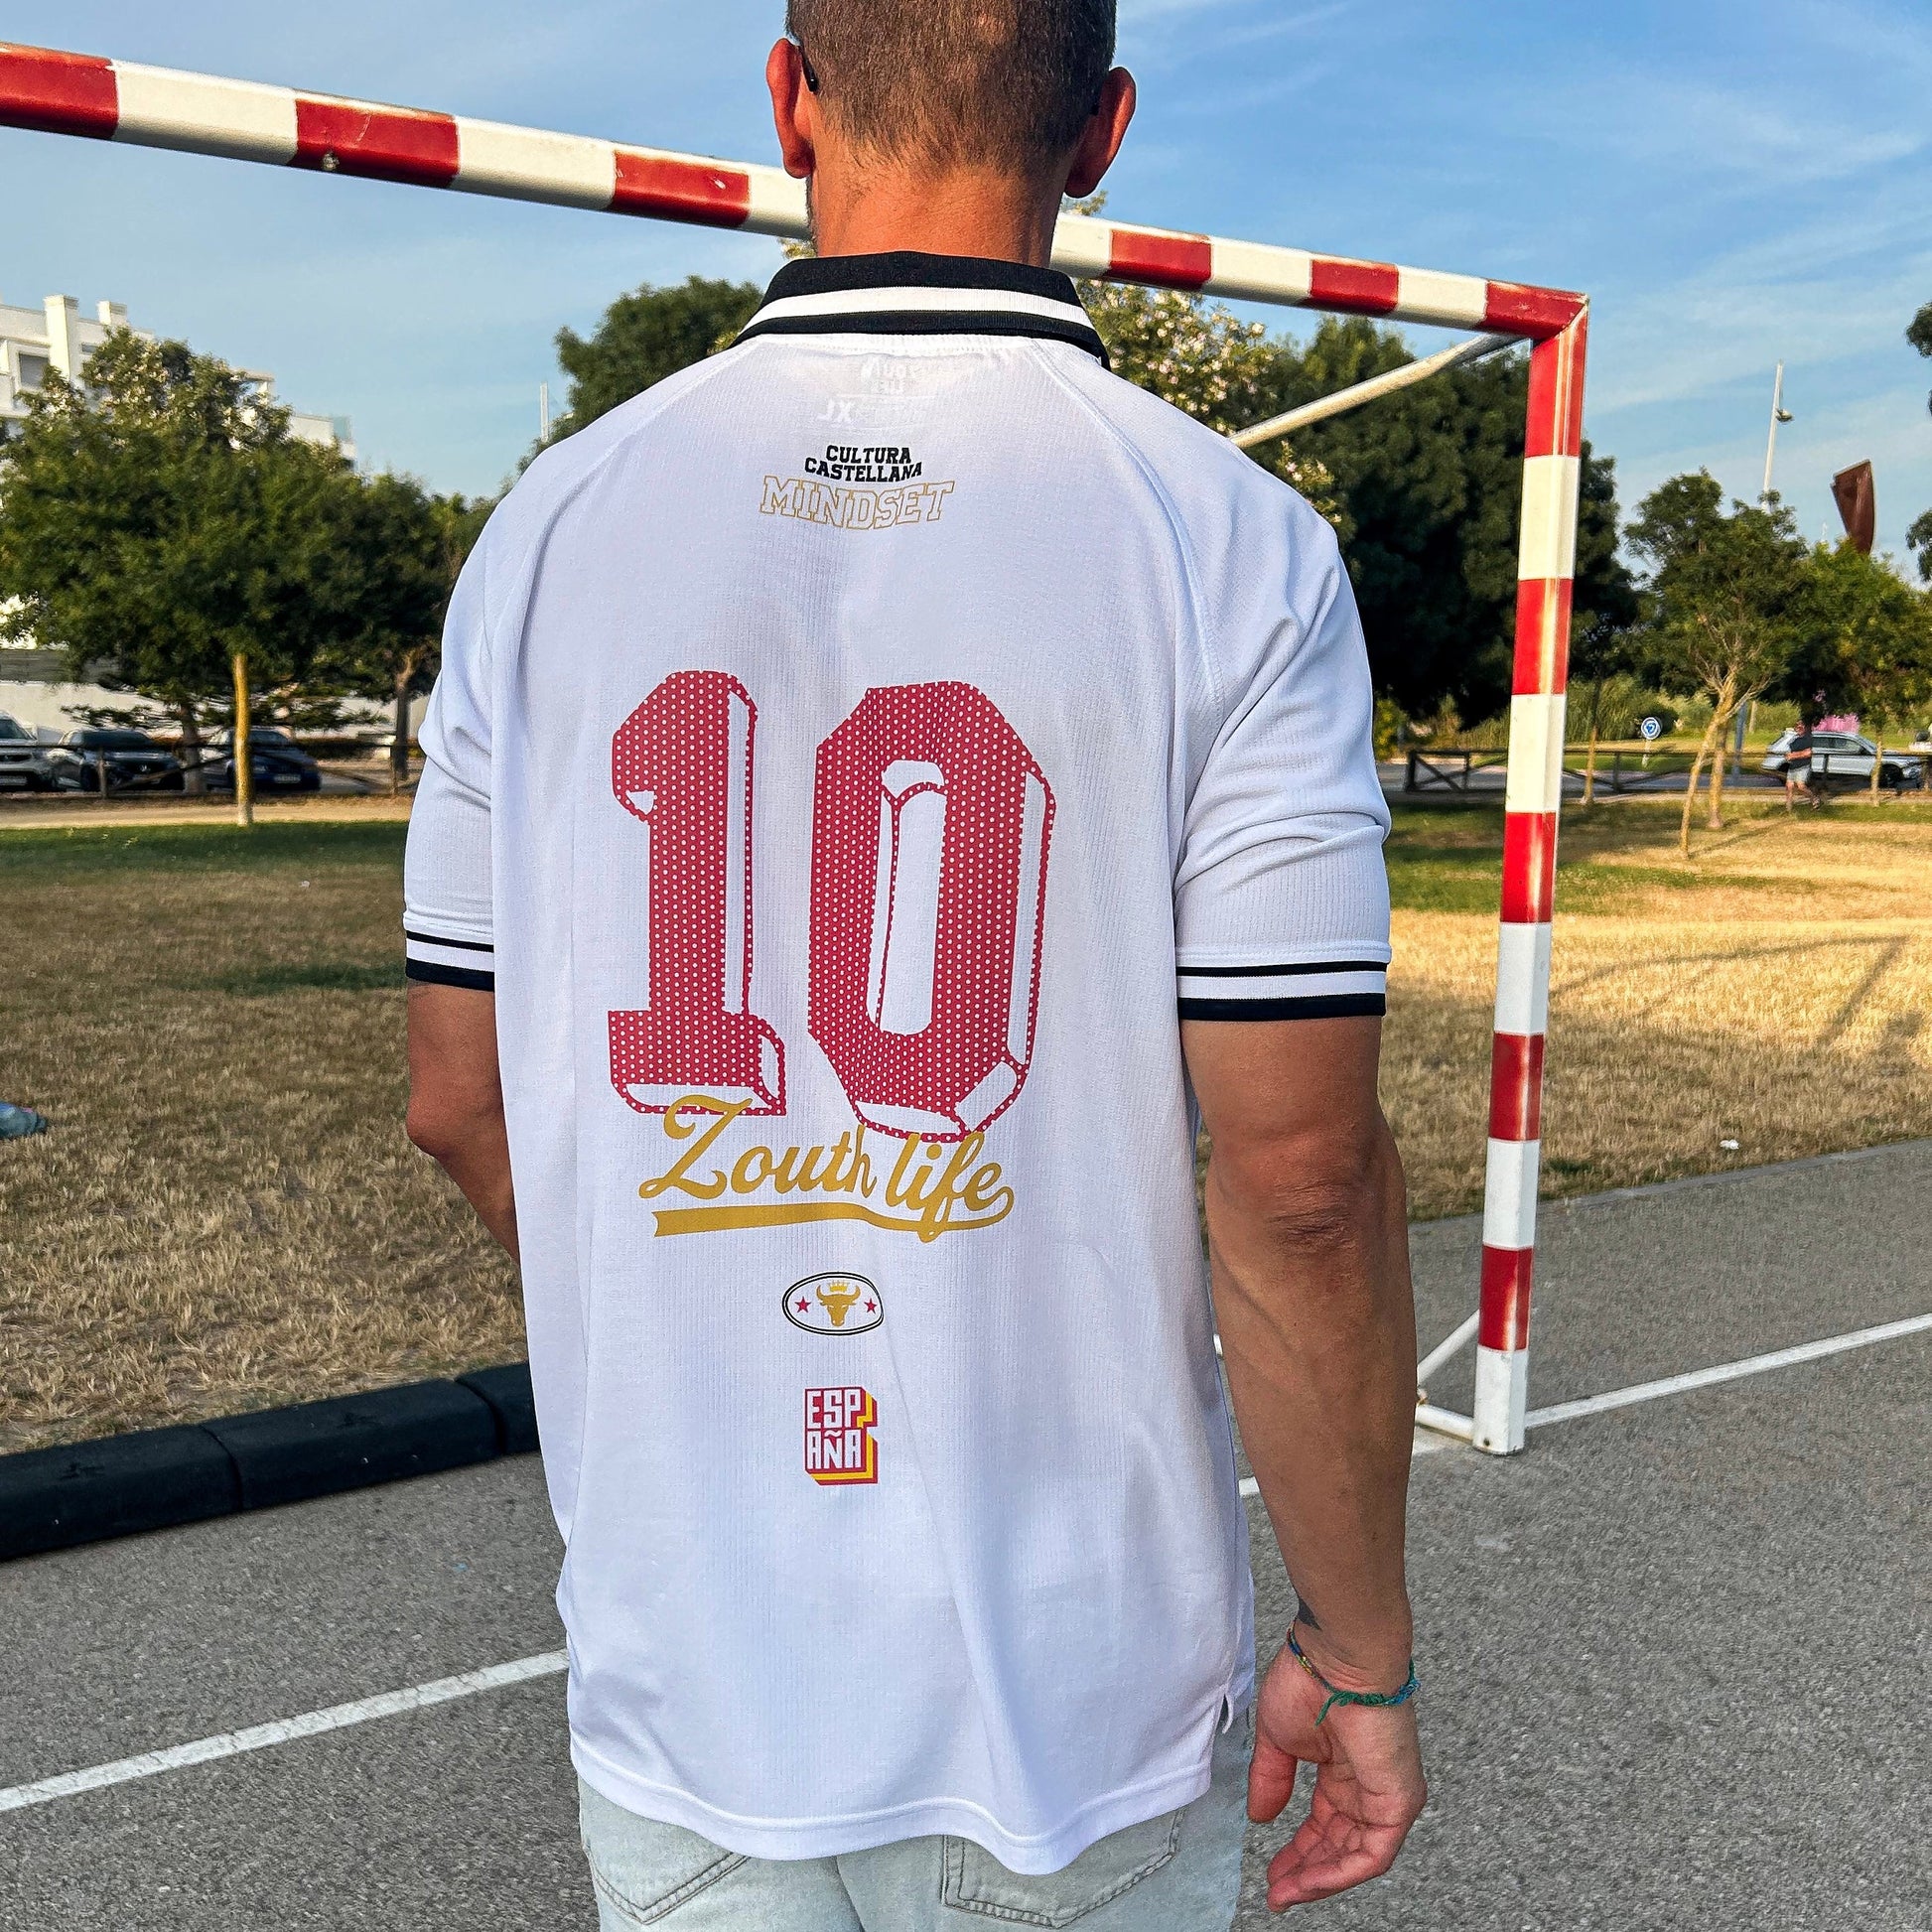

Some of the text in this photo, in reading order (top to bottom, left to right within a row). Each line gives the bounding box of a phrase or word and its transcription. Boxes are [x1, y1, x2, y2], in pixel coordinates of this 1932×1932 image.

[804, 457, 922, 483] CASTELLANA
[825, 445, 911, 464] CULTURA
[759, 475, 955, 530] MINDSET
[608, 670, 1056, 1144] 10
[638, 1094, 1015, 1243] Zouth life
[805, 1388, 863, 1429] ESP
[806, 1429, 863, 1470] AÑA
